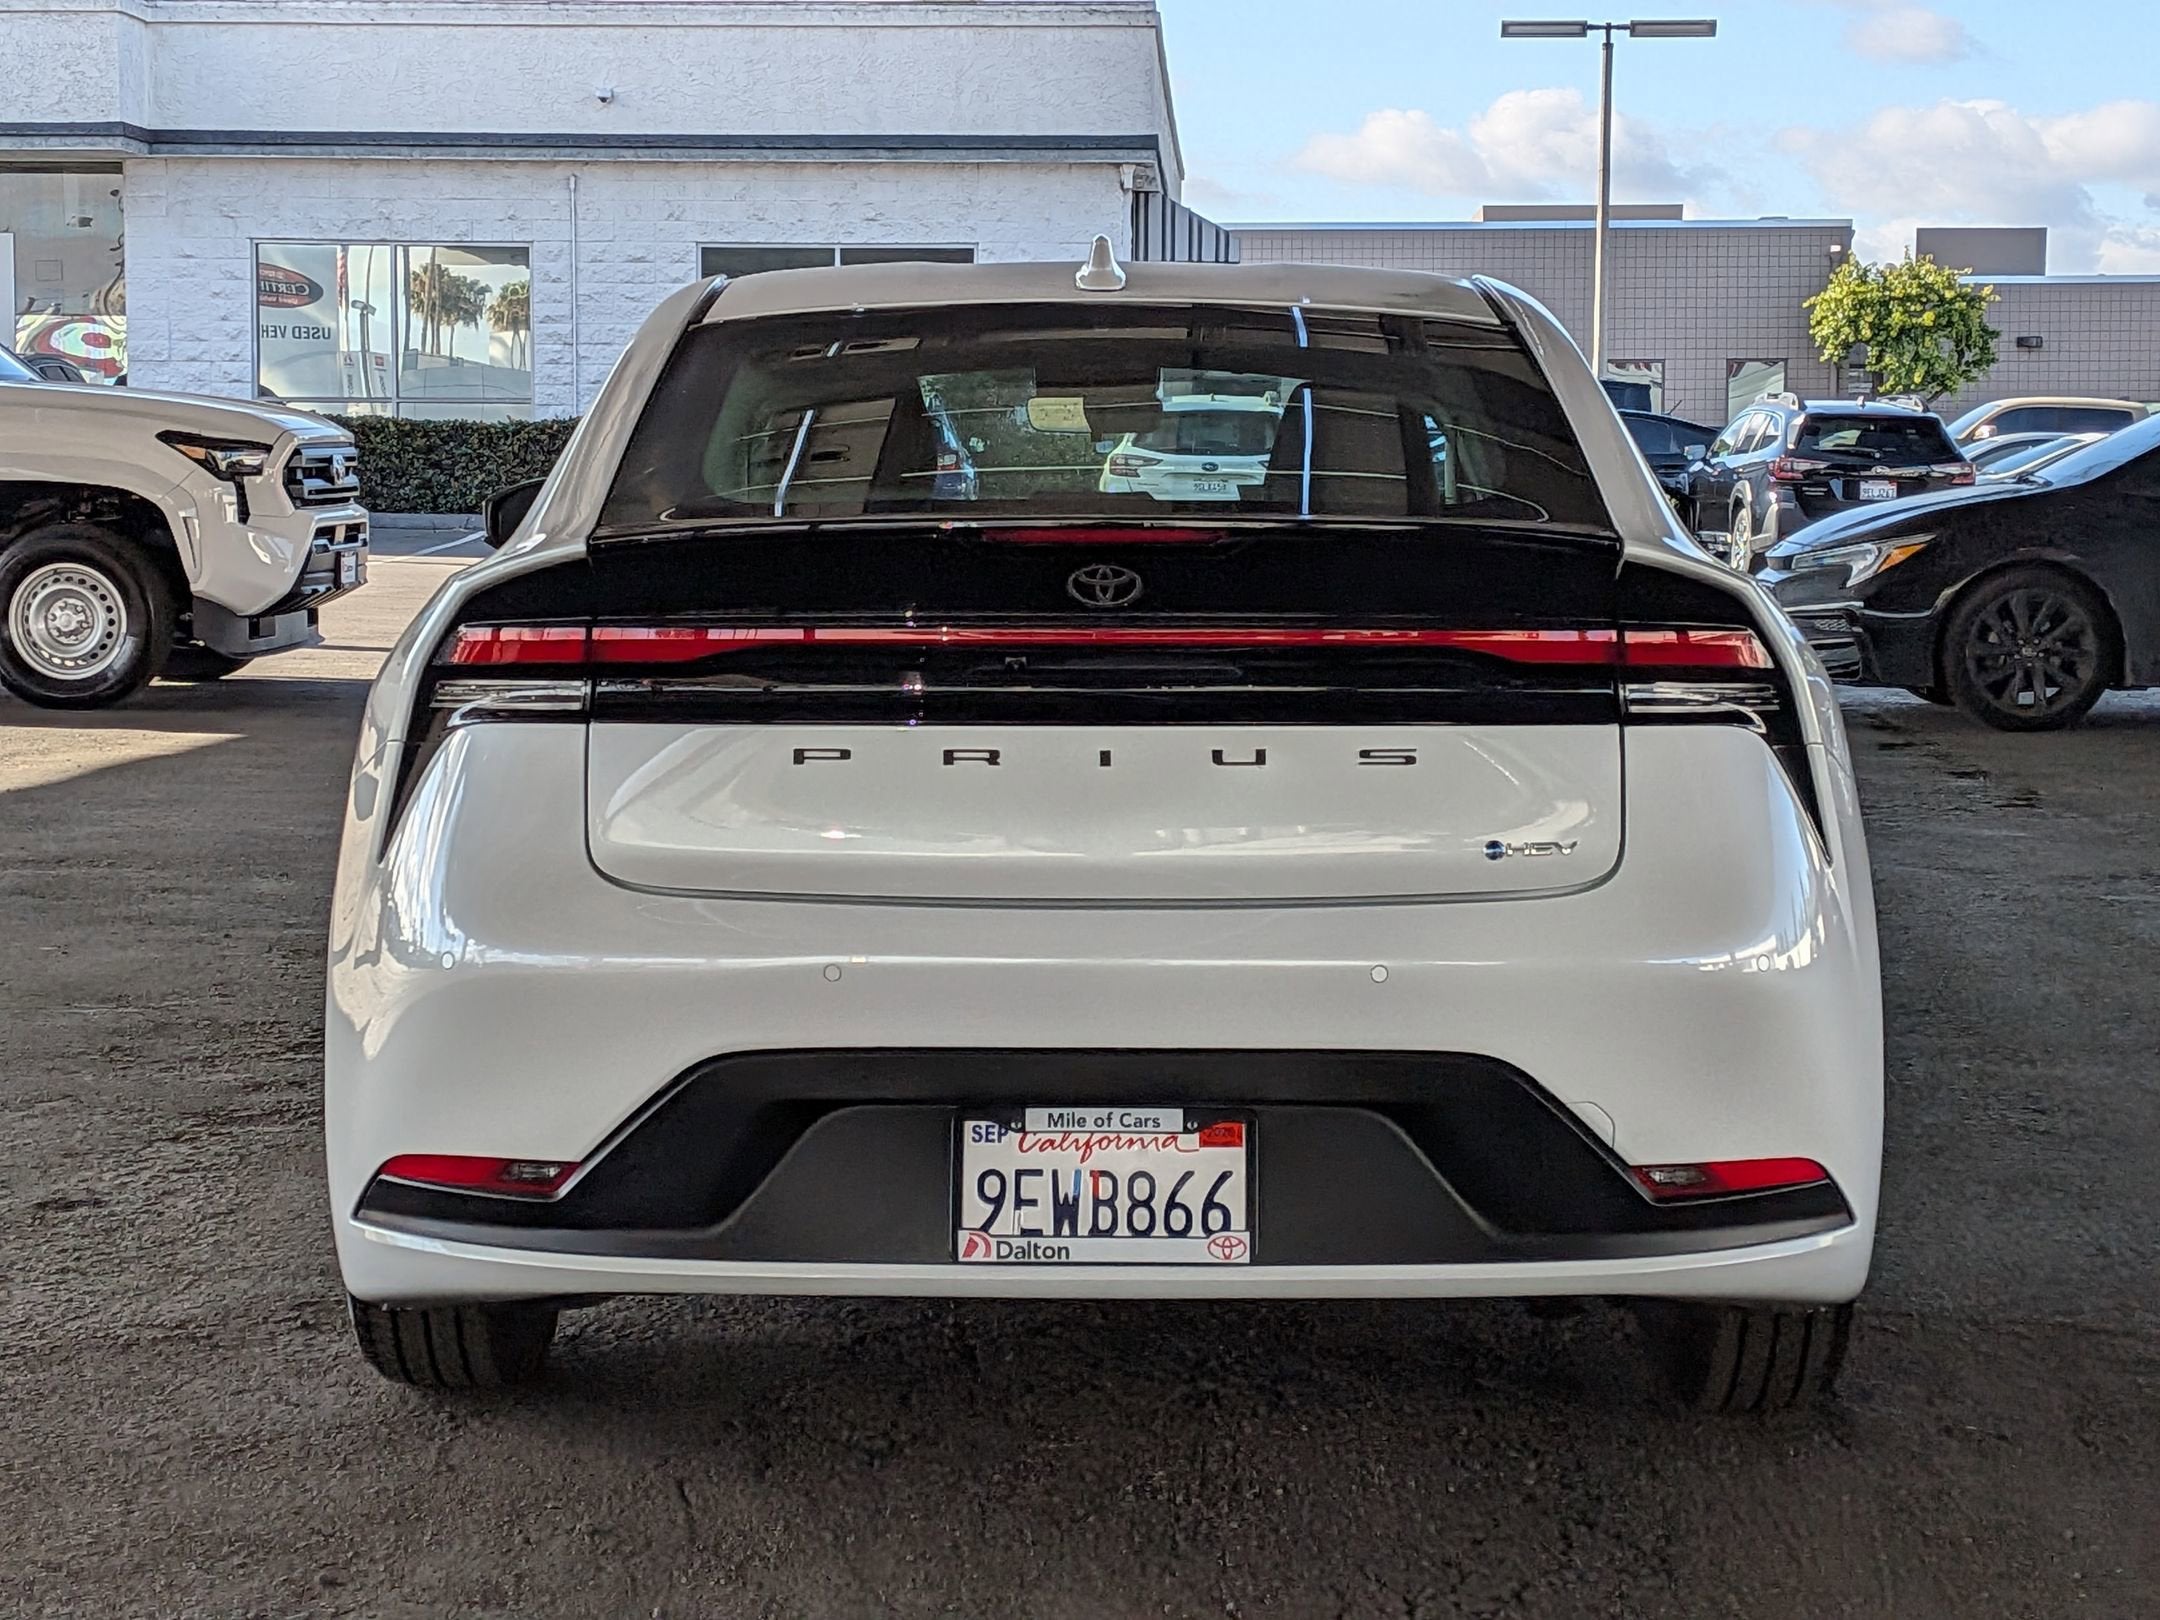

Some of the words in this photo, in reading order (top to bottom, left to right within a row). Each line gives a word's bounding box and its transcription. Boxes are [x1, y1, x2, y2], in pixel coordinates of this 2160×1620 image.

[793, 748, 1417, 766] PRIUS
[1047, 1111, 1087, 1128] Mile
[1093, 1111, 1113, 1128] of
[1119, 1112, 1161, 1128] Cars
[971, 1124, 1009, 1143] SEP
[1018, 1131, 1199, 1164] California
[977, 1168, 1234, 1237] 9EWB866
[996, 1240, 1070, 1260] Dalton
